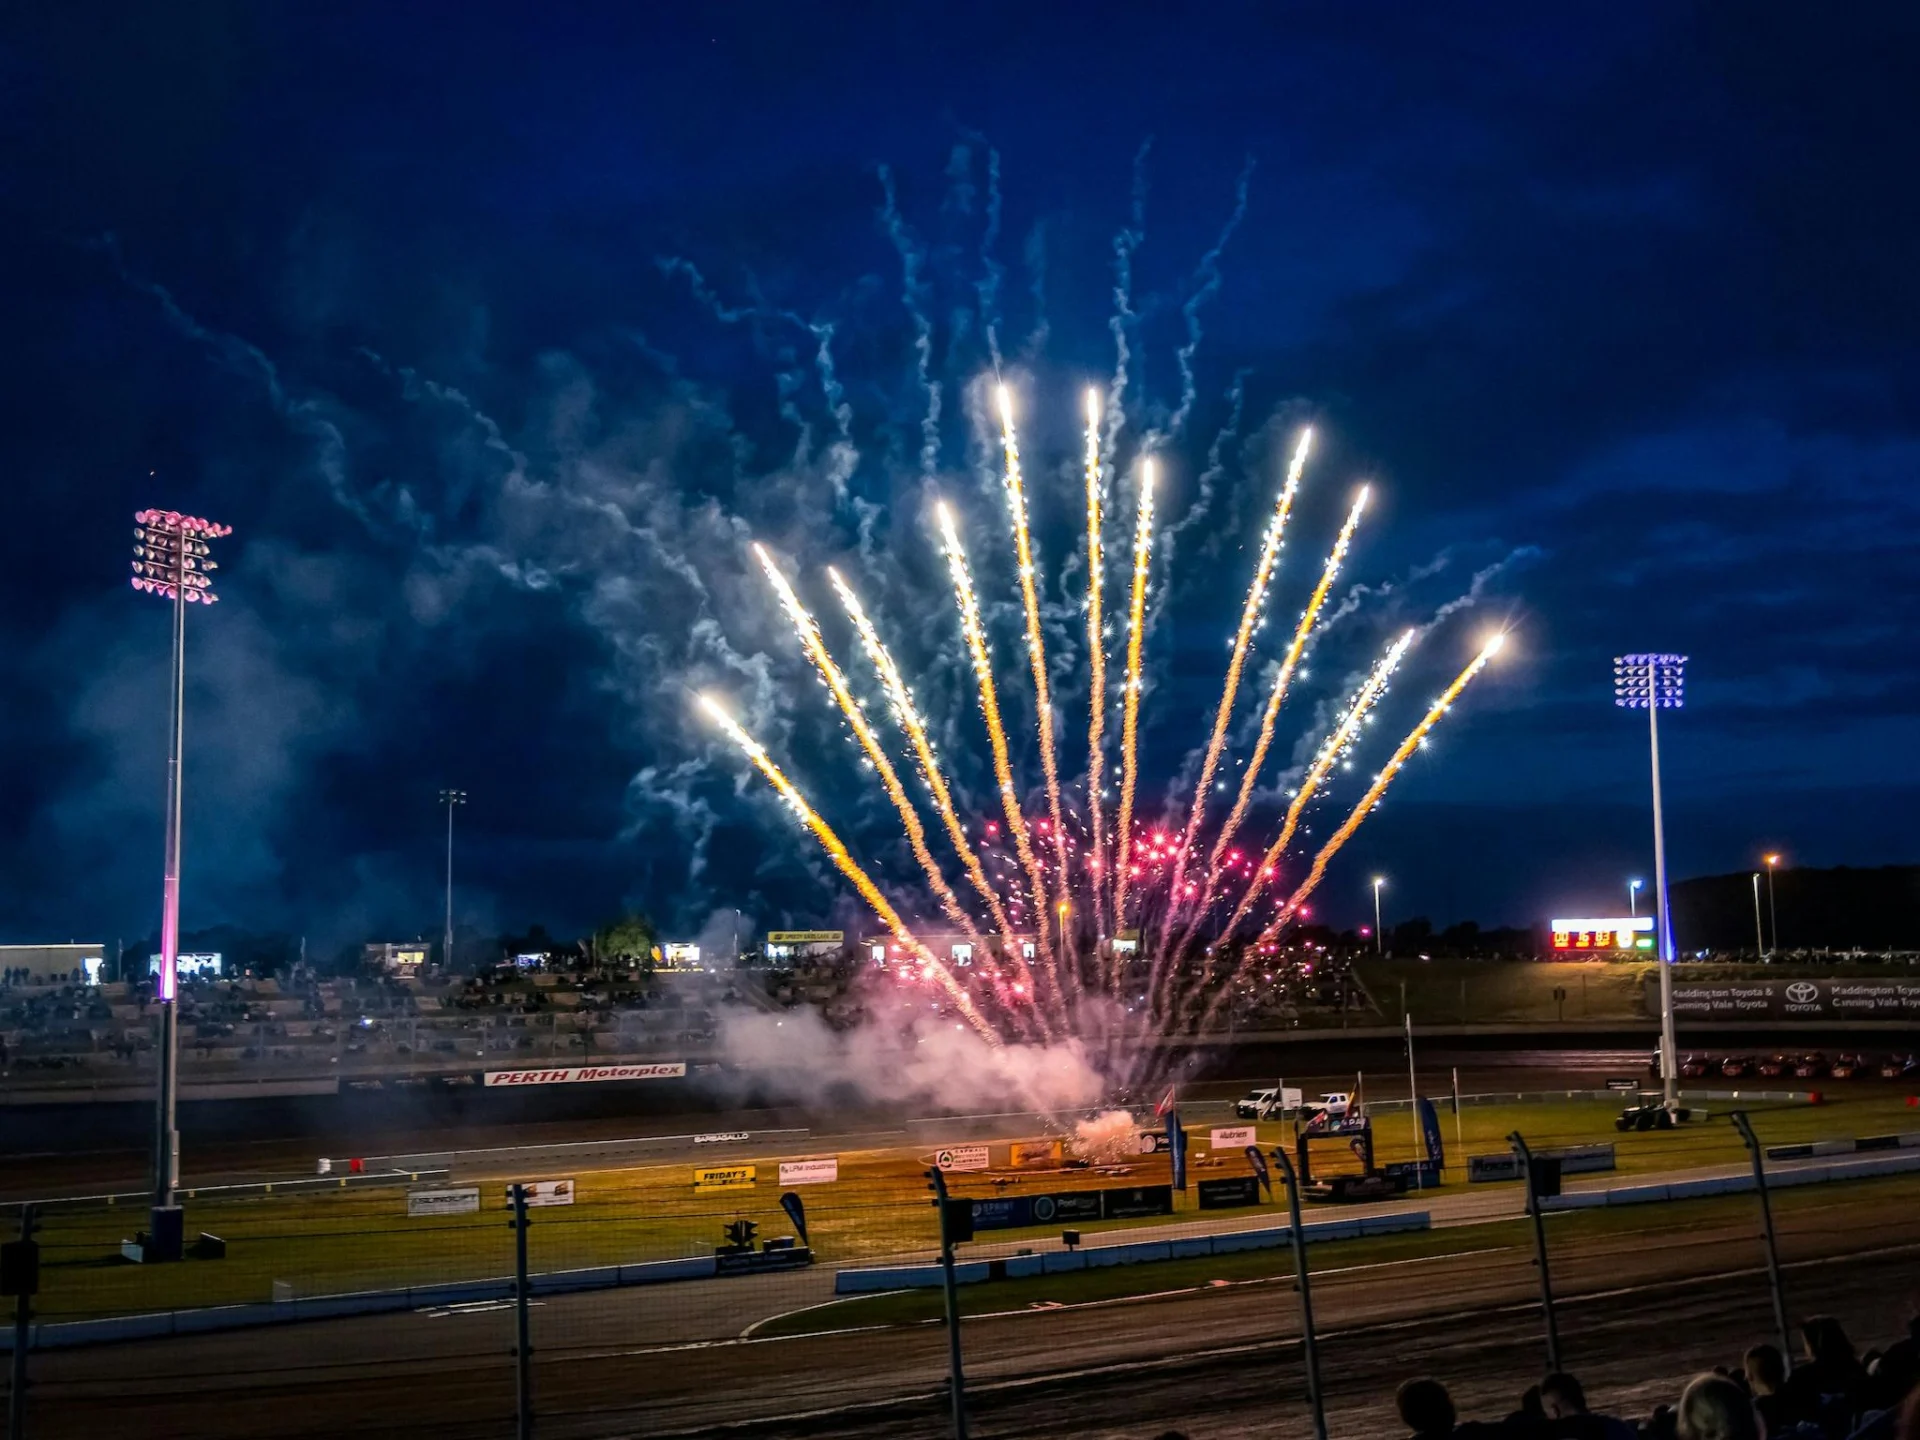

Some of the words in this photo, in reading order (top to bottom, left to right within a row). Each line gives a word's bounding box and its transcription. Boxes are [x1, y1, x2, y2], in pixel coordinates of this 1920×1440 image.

[1730, 988, 1763, 998] Toyota
[1831, 986, 1894, 996] Maddington
[1712, 1000, 1733, 1009] Vale
[1735, 1000, 1768, 1010] Toyota
[1832, 997, 1875, 1008] Canning
[1876, 997, 1899, 1007] Vale
[1784, 1004, 1822, 1012] TOYOTA
[492, 1070, 569, 1085] PERTH
[576, 1065, 681, 1081] Motorplex
[694, 1132, 749, 1143] BARBAGALLO
[1219, 1131, 1247, 1139] Nutrien
[704, 1170, 746, 1180] FRIDAY'S
